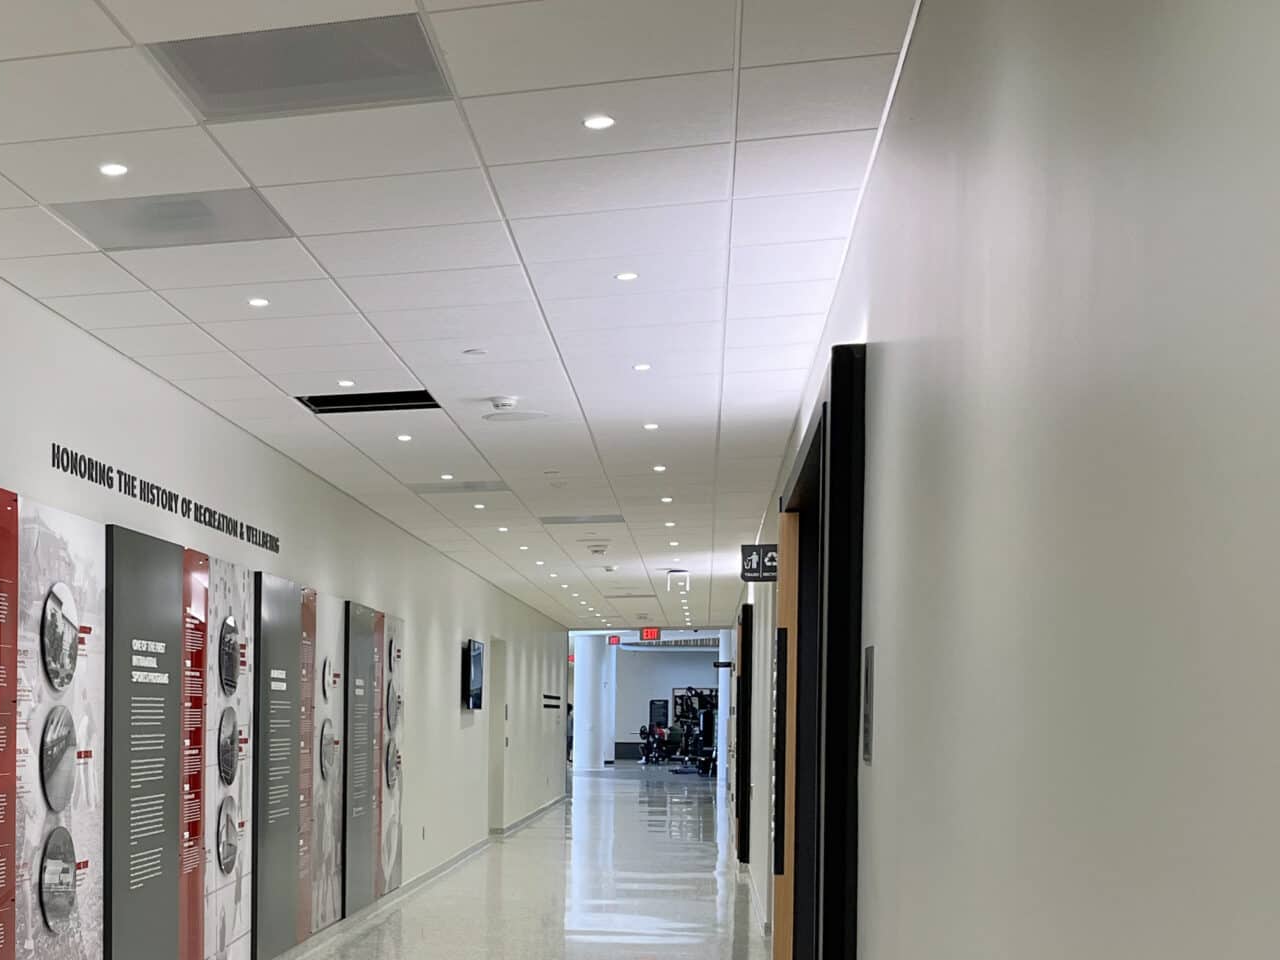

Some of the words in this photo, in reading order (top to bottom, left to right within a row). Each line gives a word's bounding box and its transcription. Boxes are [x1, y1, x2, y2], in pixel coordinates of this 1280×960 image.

[51, 442, 114, 489] HONORING
[116, 469, 137, 498] THE
[139, 479, 180, 515] HISTORY
[181, 496, 193, 519] OF
[194, 502, 238, 538] RECREATION
[239, 523, 244, 540] &
[246, 524, 280, 554] WELLBEING
[643, 628, 658, 640] EXIT
